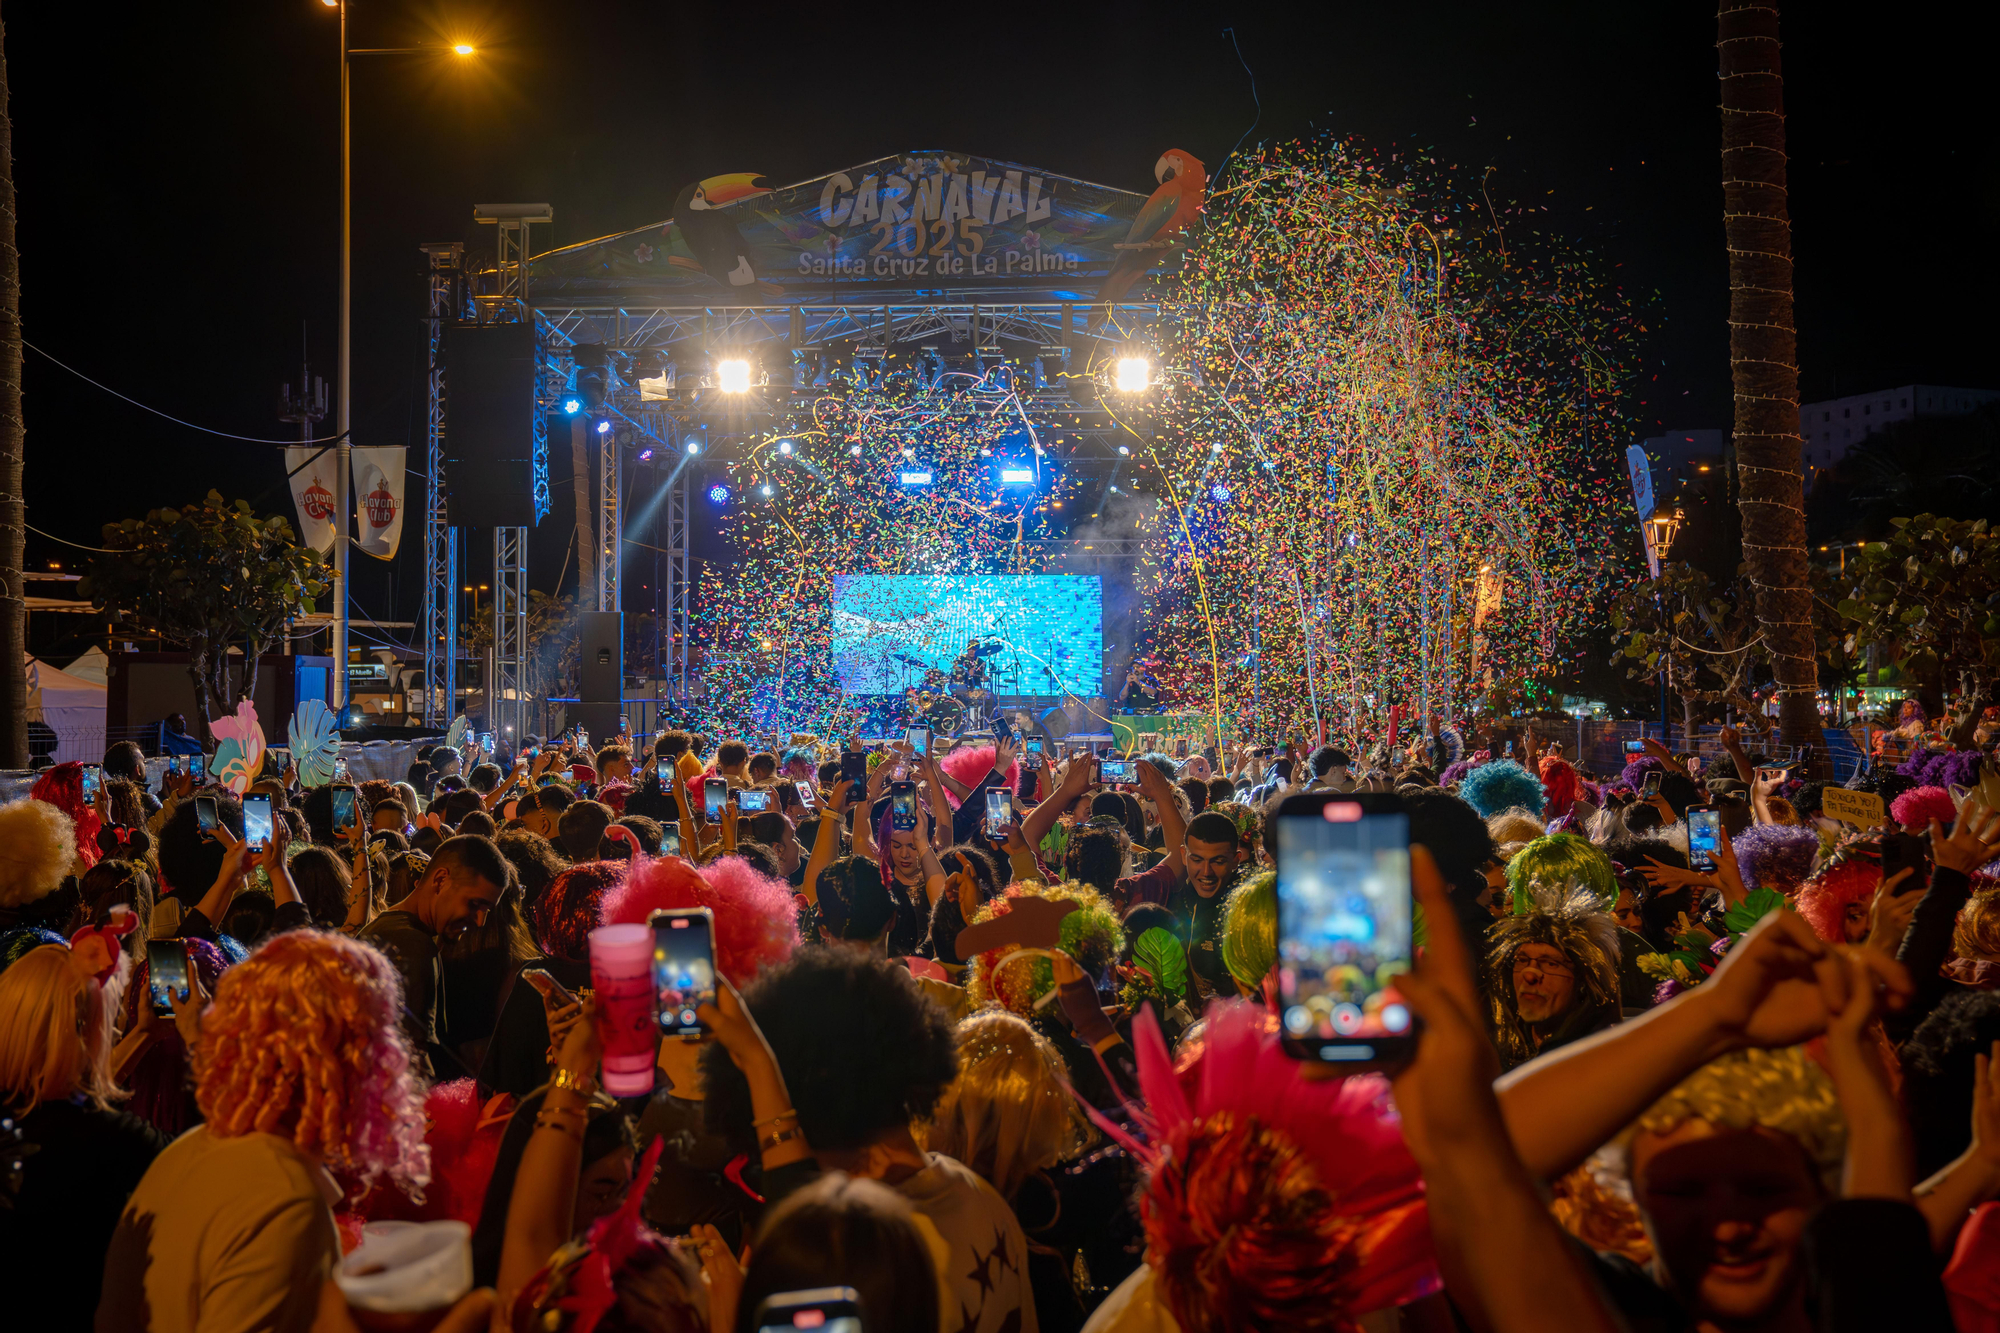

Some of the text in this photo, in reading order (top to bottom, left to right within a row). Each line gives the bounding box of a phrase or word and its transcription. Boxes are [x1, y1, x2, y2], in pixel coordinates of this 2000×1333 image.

[820, 171, 1051, 228] CARNAVAL
[868, 218, 983, 257] 2025
[798, 249, 1078, 275] Santa Cruz de La Palma
[296, 492, 337, 506] Havana
[360, 494, 401, 509] Havana
[370, 509, 391, 521] Club
